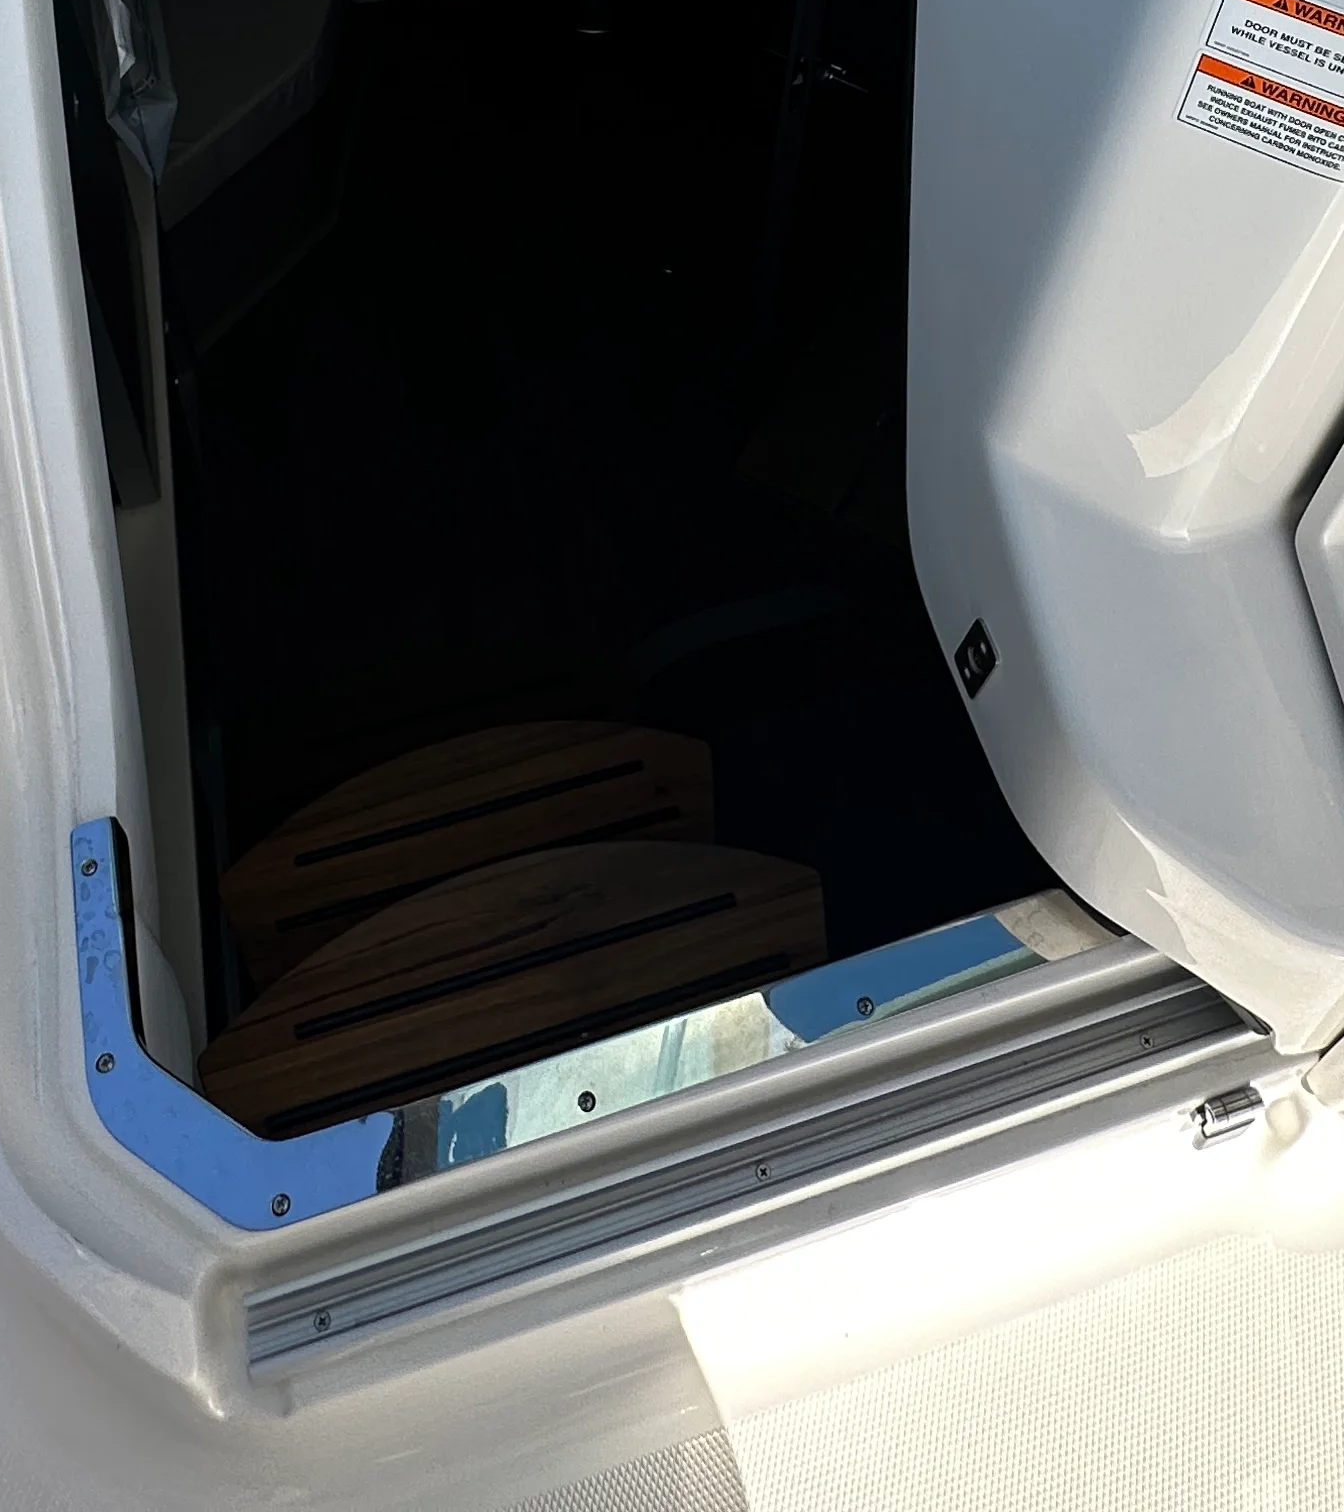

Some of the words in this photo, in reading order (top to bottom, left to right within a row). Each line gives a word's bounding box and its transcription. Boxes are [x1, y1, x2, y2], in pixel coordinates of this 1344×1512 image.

[1230, 25, 1266, 45] WHILE
[1267, 39, 1313, 62] VESSEL
[1313, 57, 1326, 67] IS
[1243, 19, 1278, 38] DOOR
[1279, 32, 1311, 50] MUST
[1313, 45, 1332, 57] BE
[1197, 100, 1214, 111] SEE
[1213, 107, 1248, 125] OWNERS
[1249, 120, 1283, 139] MANUAL
[1283, 134, 1302, 146] FOR
[1206, 84, 1243, 103] RUNNING
[1243, 98, 1266, 112] BOAT
[1266, 107, 1288, 120] WITH
[1288, 115, 1313, 130] DOOR
[1313, 125, 1337, 139] OPEN
[1208, 114, 1261, 140] CONCERNING
[1260, 134, 1296, 153] CARBON
[1209, 95, 1240, 112] INDUCE
[1240, 107, 1278, 127] EXHAUST
[1278, 121, 1307, 138] FUMES
[1307, 132, 1327, 145] INTO
